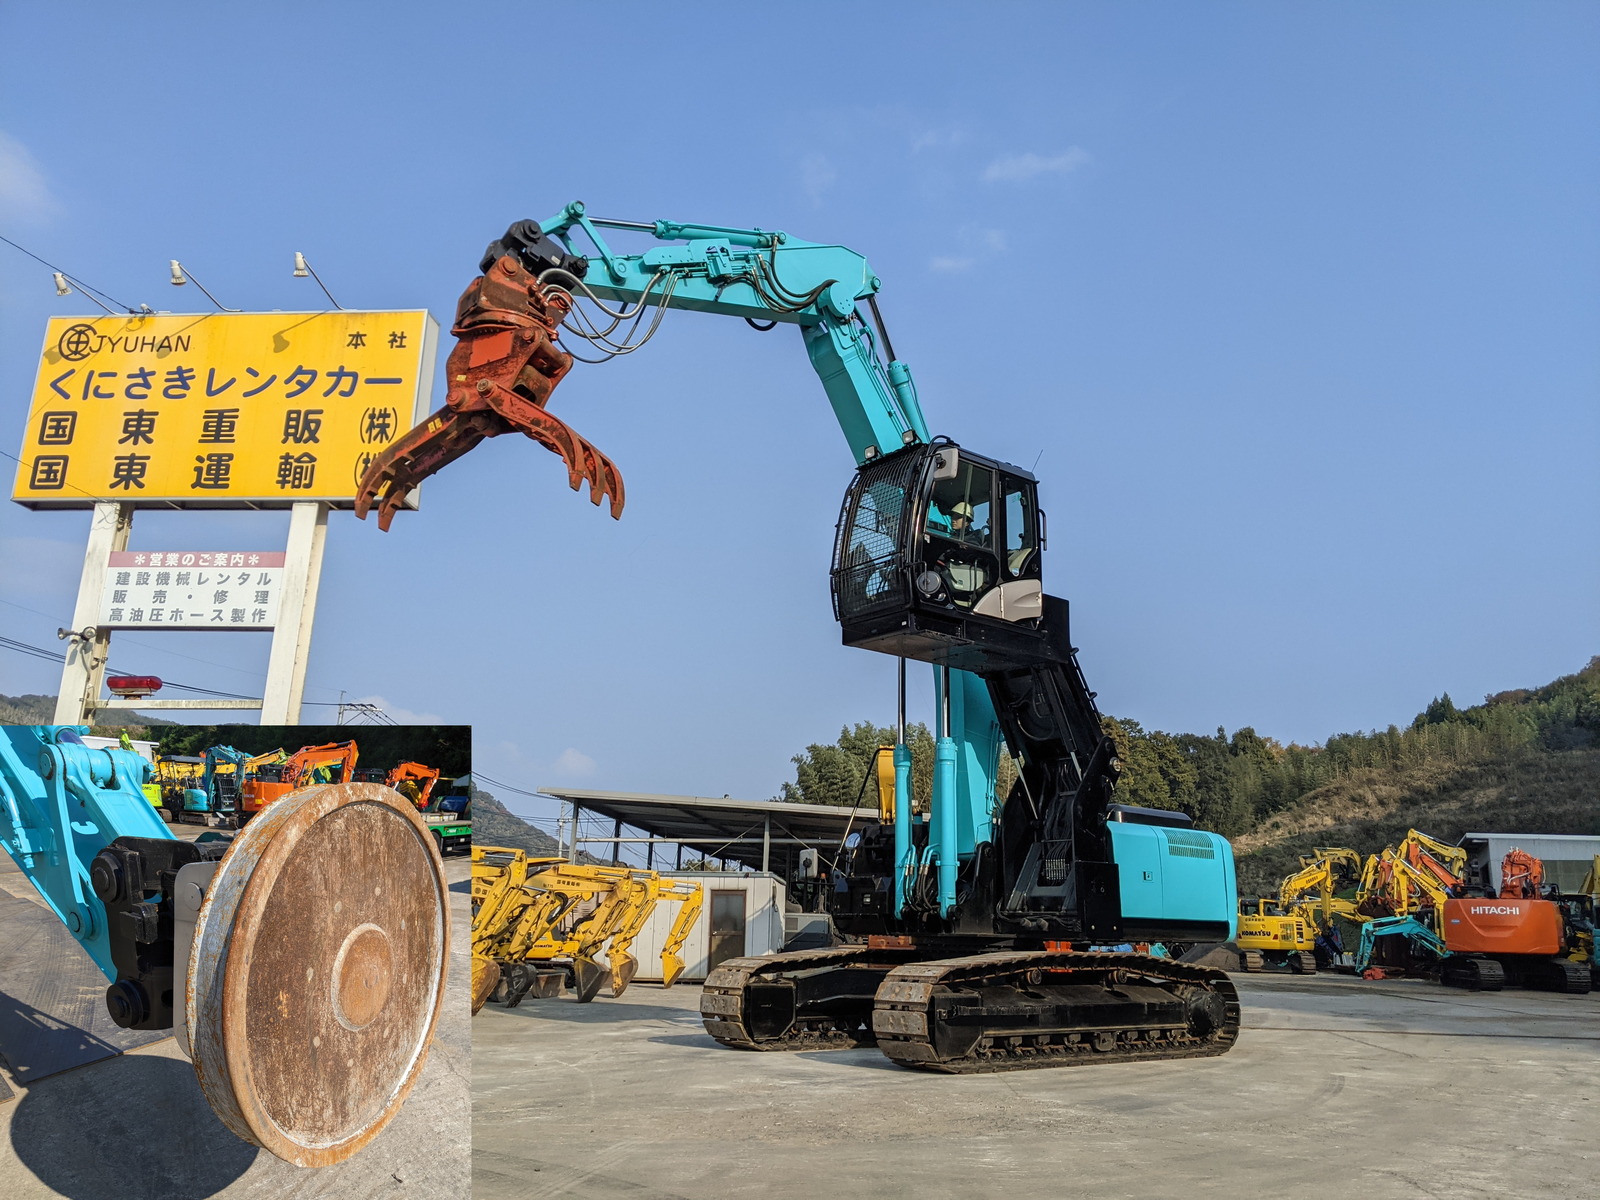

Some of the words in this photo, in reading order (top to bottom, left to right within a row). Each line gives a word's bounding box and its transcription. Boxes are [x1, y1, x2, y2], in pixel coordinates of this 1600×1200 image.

[88, 334, 191, 353] JYUHAN
[346, 331, 407, 349] 本社
[49, 365, 403, 401] くにさきレンタカー
[115, 571, 272, 587] 建設機械レンタル
[112, 589, 270, 605] 販売・修理
[108, 607, 267, 623] 高油圧ホース製作
[1470, 906, 1520, 915] HITACHI
